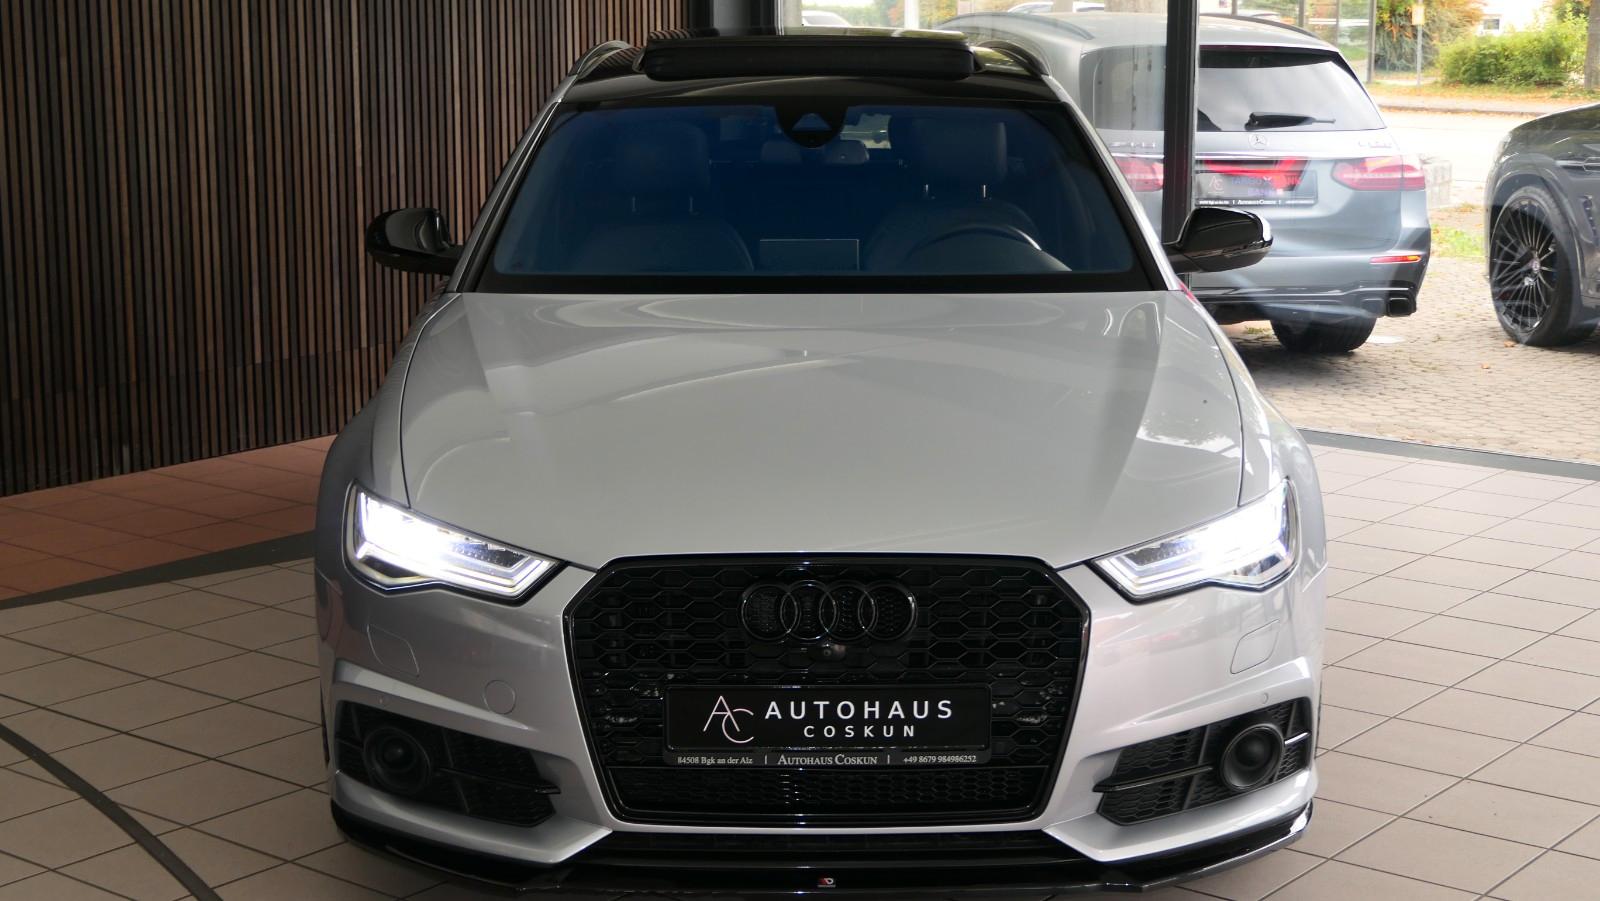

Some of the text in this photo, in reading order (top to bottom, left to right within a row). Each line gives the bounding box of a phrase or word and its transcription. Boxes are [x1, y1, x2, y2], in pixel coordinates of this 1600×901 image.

[764, 700, 953, 720] AUTOHAUS
[803, 725, 915, 738] COSKUN
[727, 756, 739, 764] der
